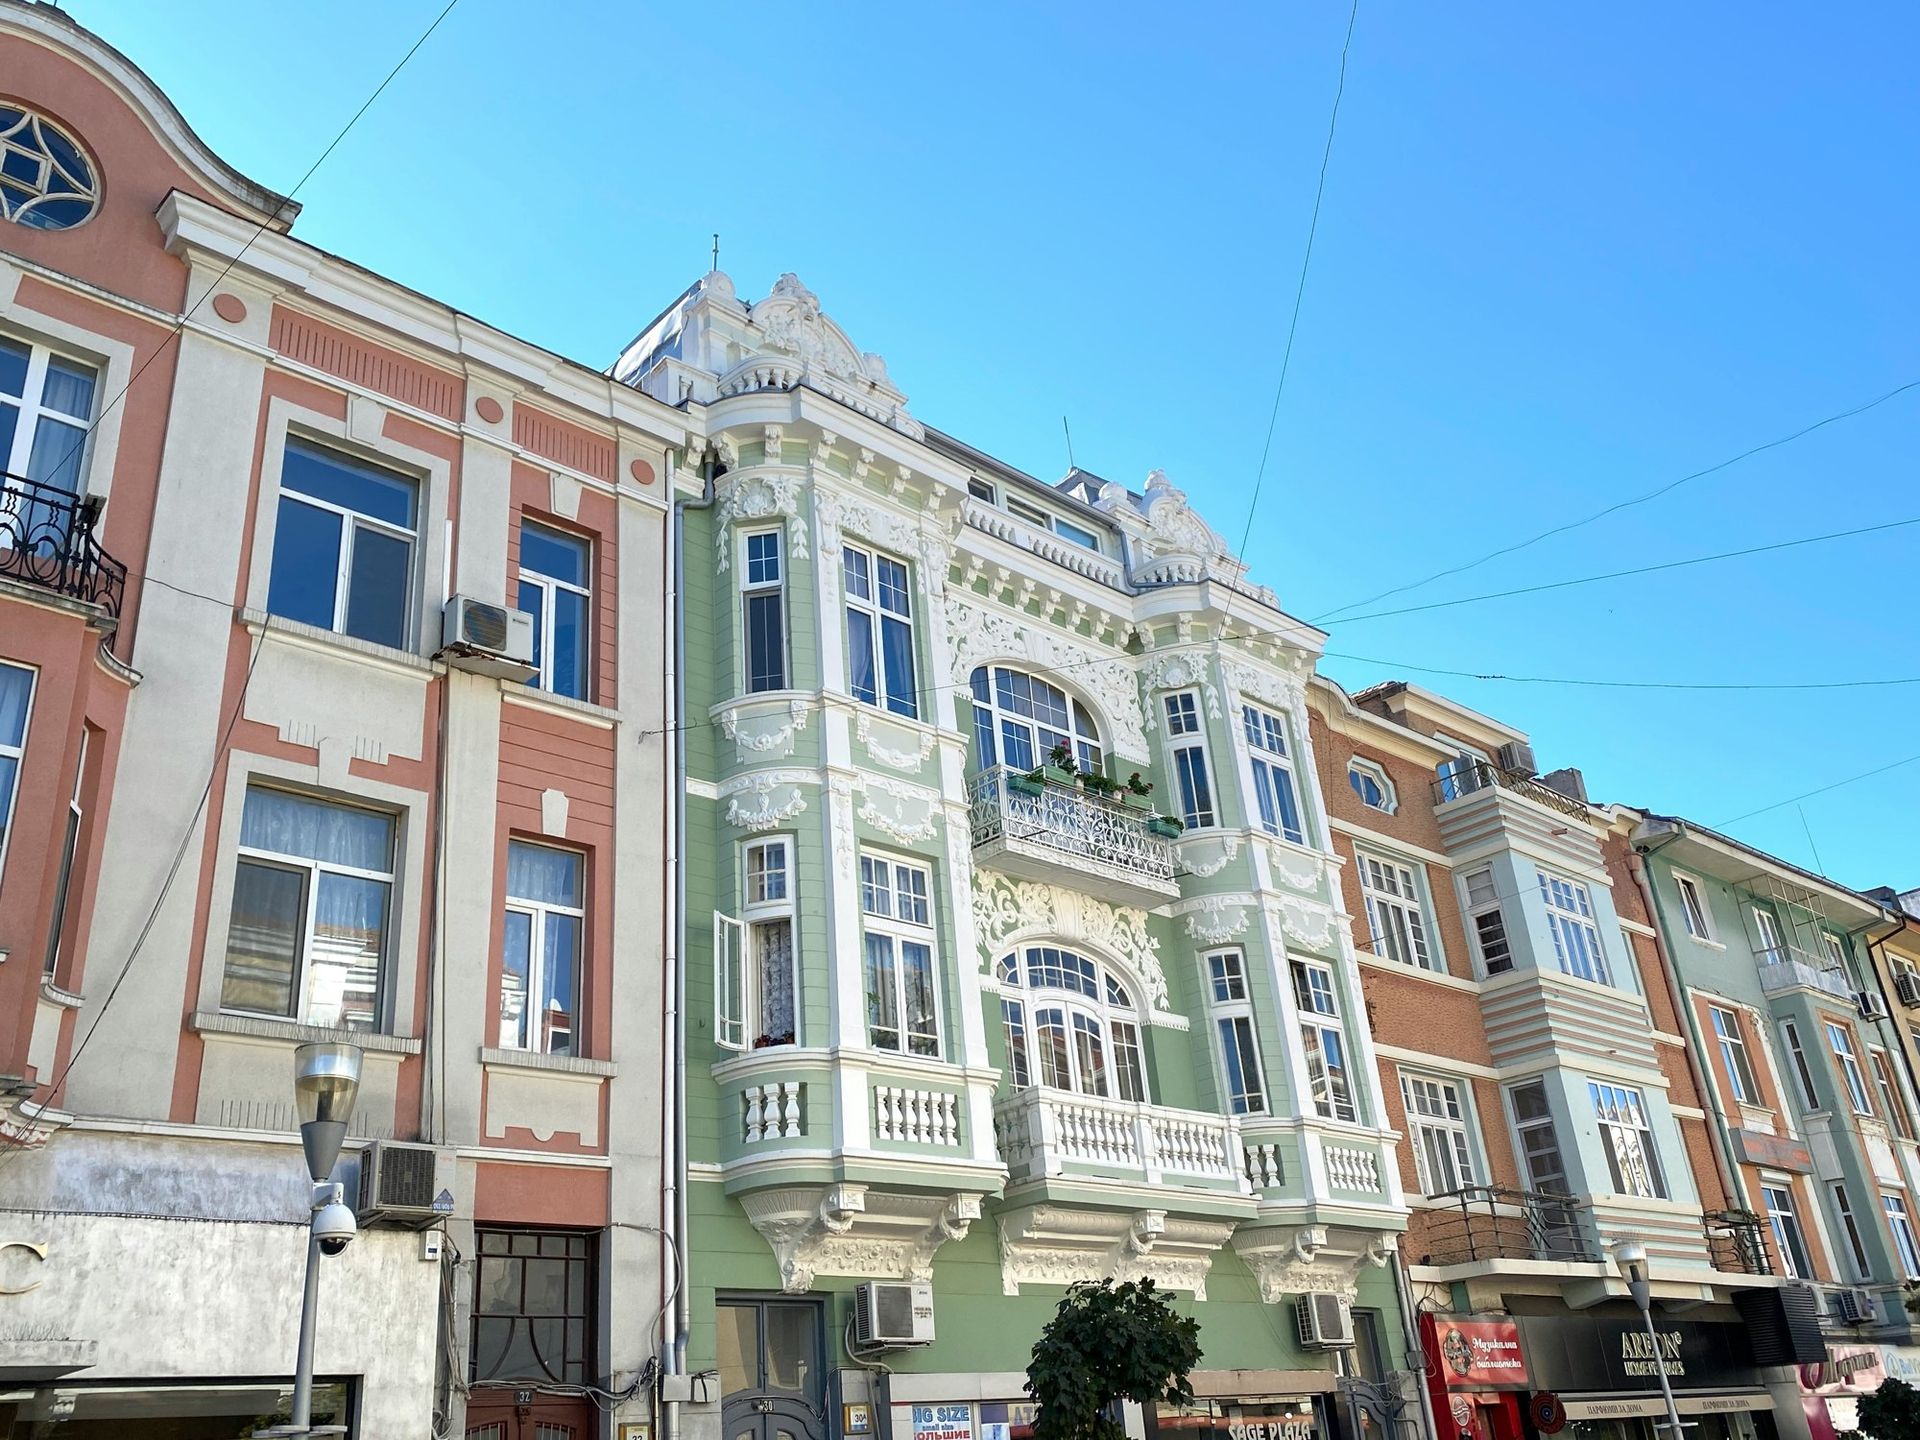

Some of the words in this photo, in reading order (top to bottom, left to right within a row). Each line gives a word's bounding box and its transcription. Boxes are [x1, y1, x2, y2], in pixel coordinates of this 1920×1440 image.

[1476, 1355, 1522, 1369] библиотека
[519, 1391, 531, 1402] 32
[763, 1400, 773, 1411] 30
[937, 1406, 970, 1422] SIZE
[914, 1430, 970, 1440] ОЛЬШИЕ
[1267, 1420, 1311, 1440] PLAZA
